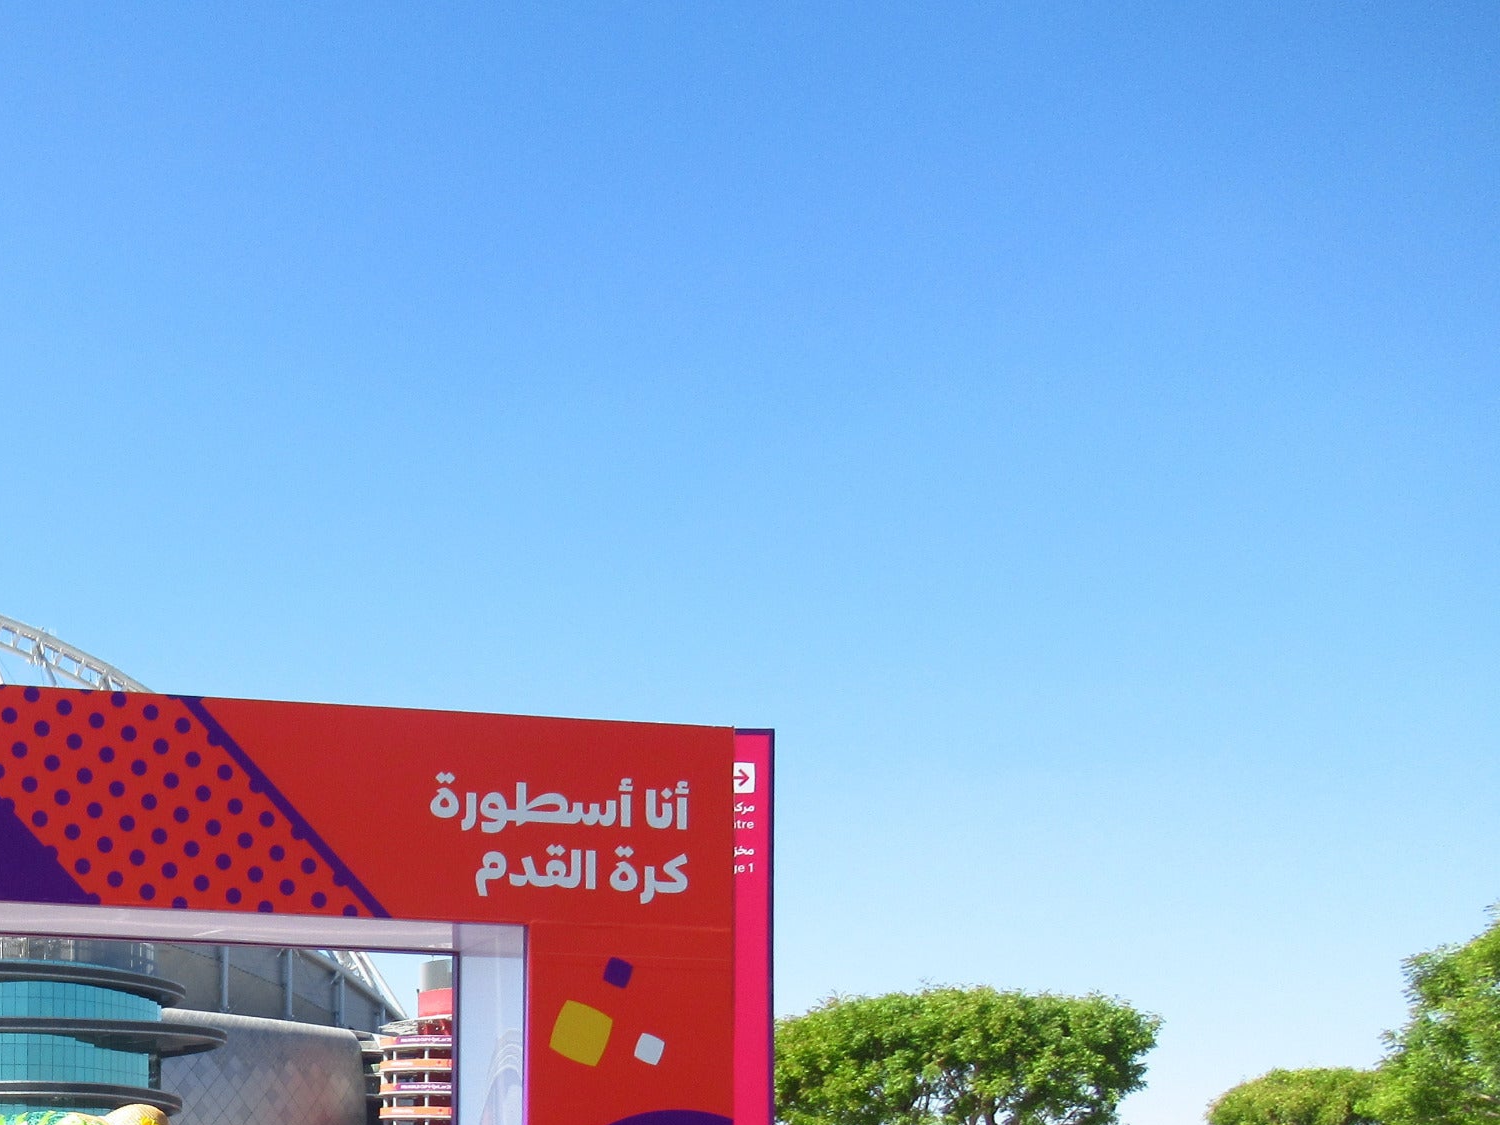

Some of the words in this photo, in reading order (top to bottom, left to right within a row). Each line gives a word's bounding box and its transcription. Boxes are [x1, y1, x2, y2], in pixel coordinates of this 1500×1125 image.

[429, 771, 634, 834] أسطورة
[645, 780, 690, 830] أنا
[475, 844, 597, 897] القدم
[609, 845, 689, 905] كرة
